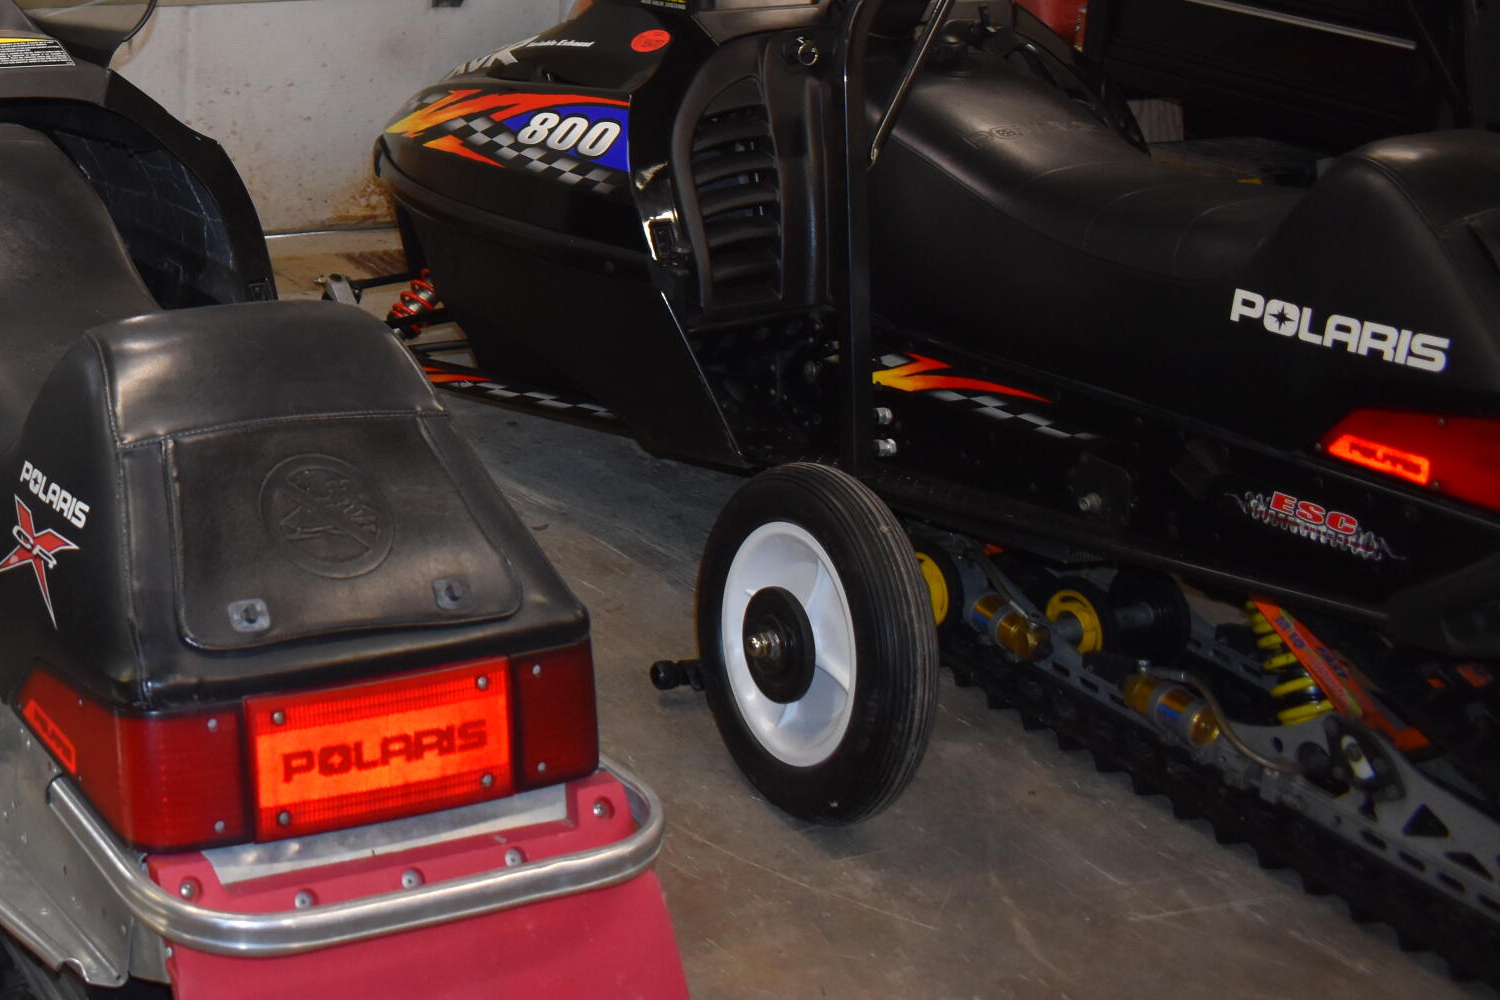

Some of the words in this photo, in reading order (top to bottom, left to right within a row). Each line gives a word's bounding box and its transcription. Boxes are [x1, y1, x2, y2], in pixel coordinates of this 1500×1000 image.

[516, 111, 621, 158] 800
[1229, 288, 1451, 373] POLARIS
[20, 460, 90, 529] POLARIS
[1269, 490, 1358, 535] ESC
[282, 719, 488, 784] POLARIS
